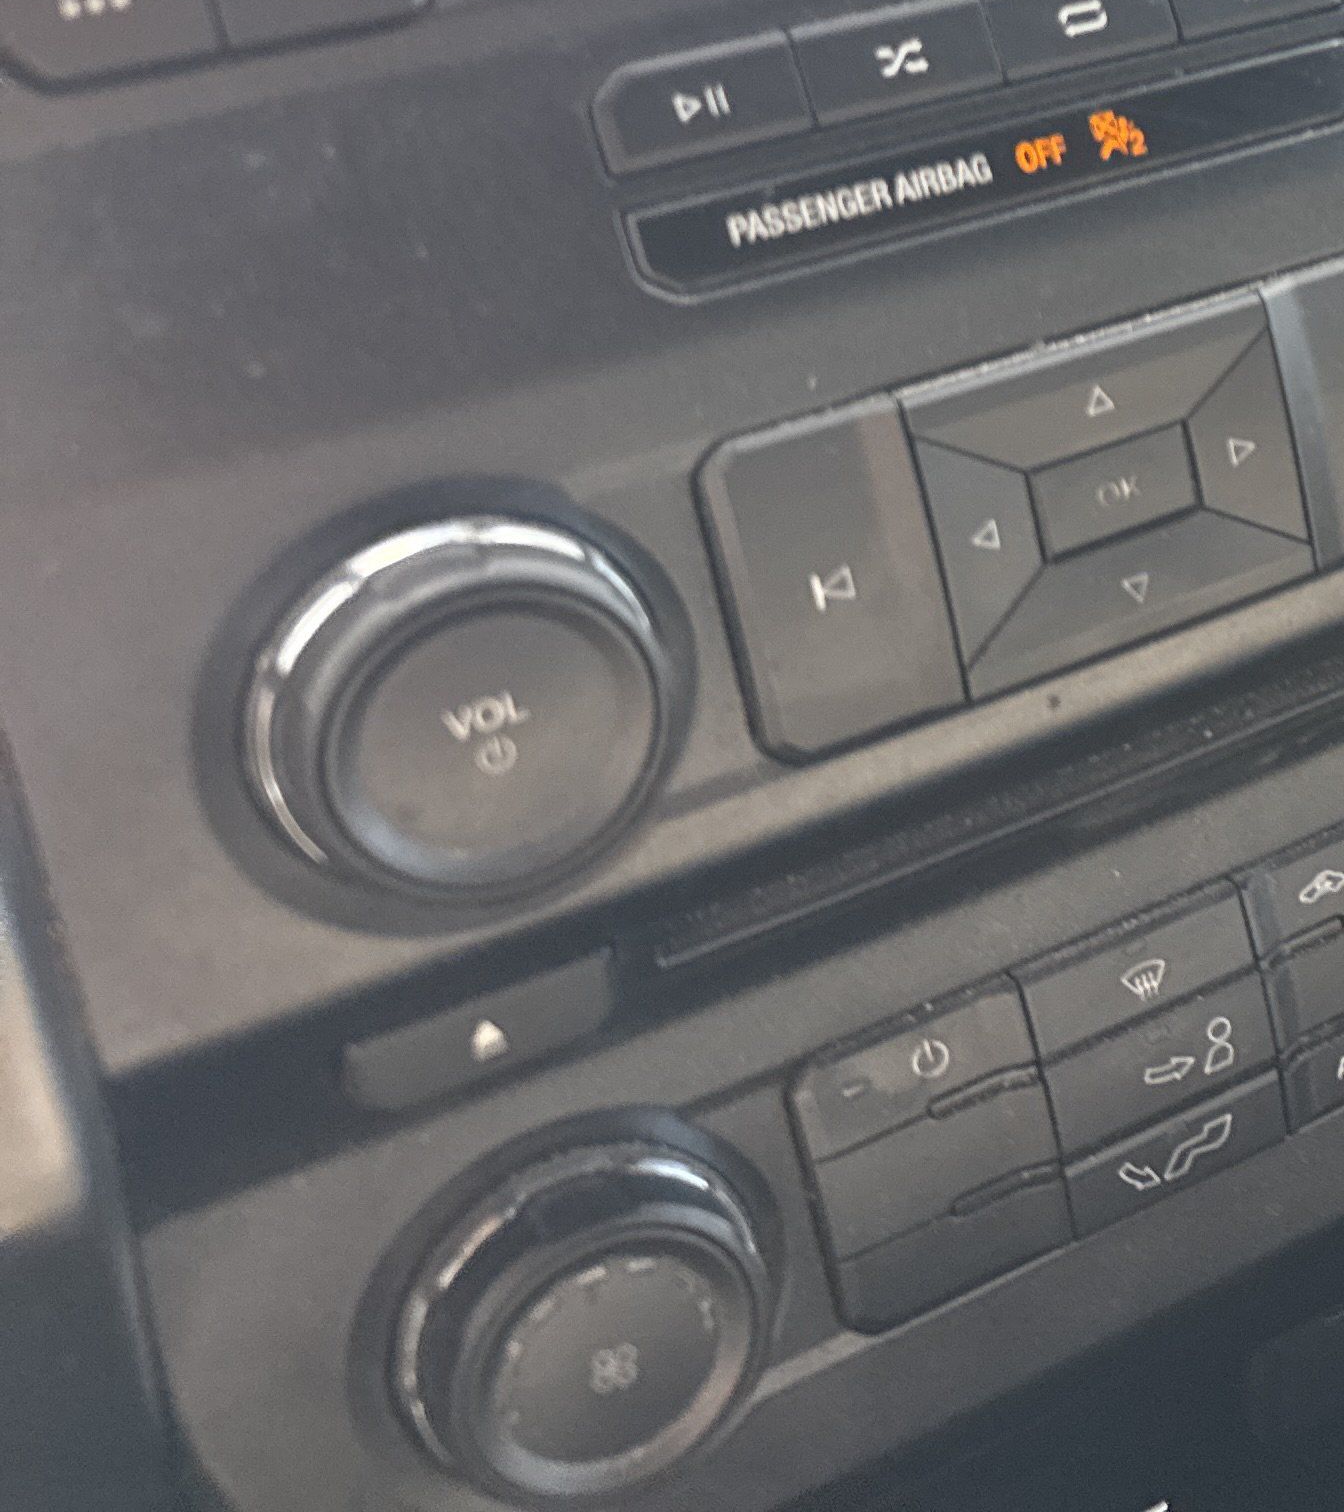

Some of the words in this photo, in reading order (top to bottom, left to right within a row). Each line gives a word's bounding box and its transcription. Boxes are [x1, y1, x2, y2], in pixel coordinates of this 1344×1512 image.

[726, 178, 894, 248] PASSENGER
[893, 152, 993, 205] AIRBAG
[1014, 133, 1067, 175] OFF
[1097, 477, 1141, 506] OK
[441, 690, 530, 741] VOL
